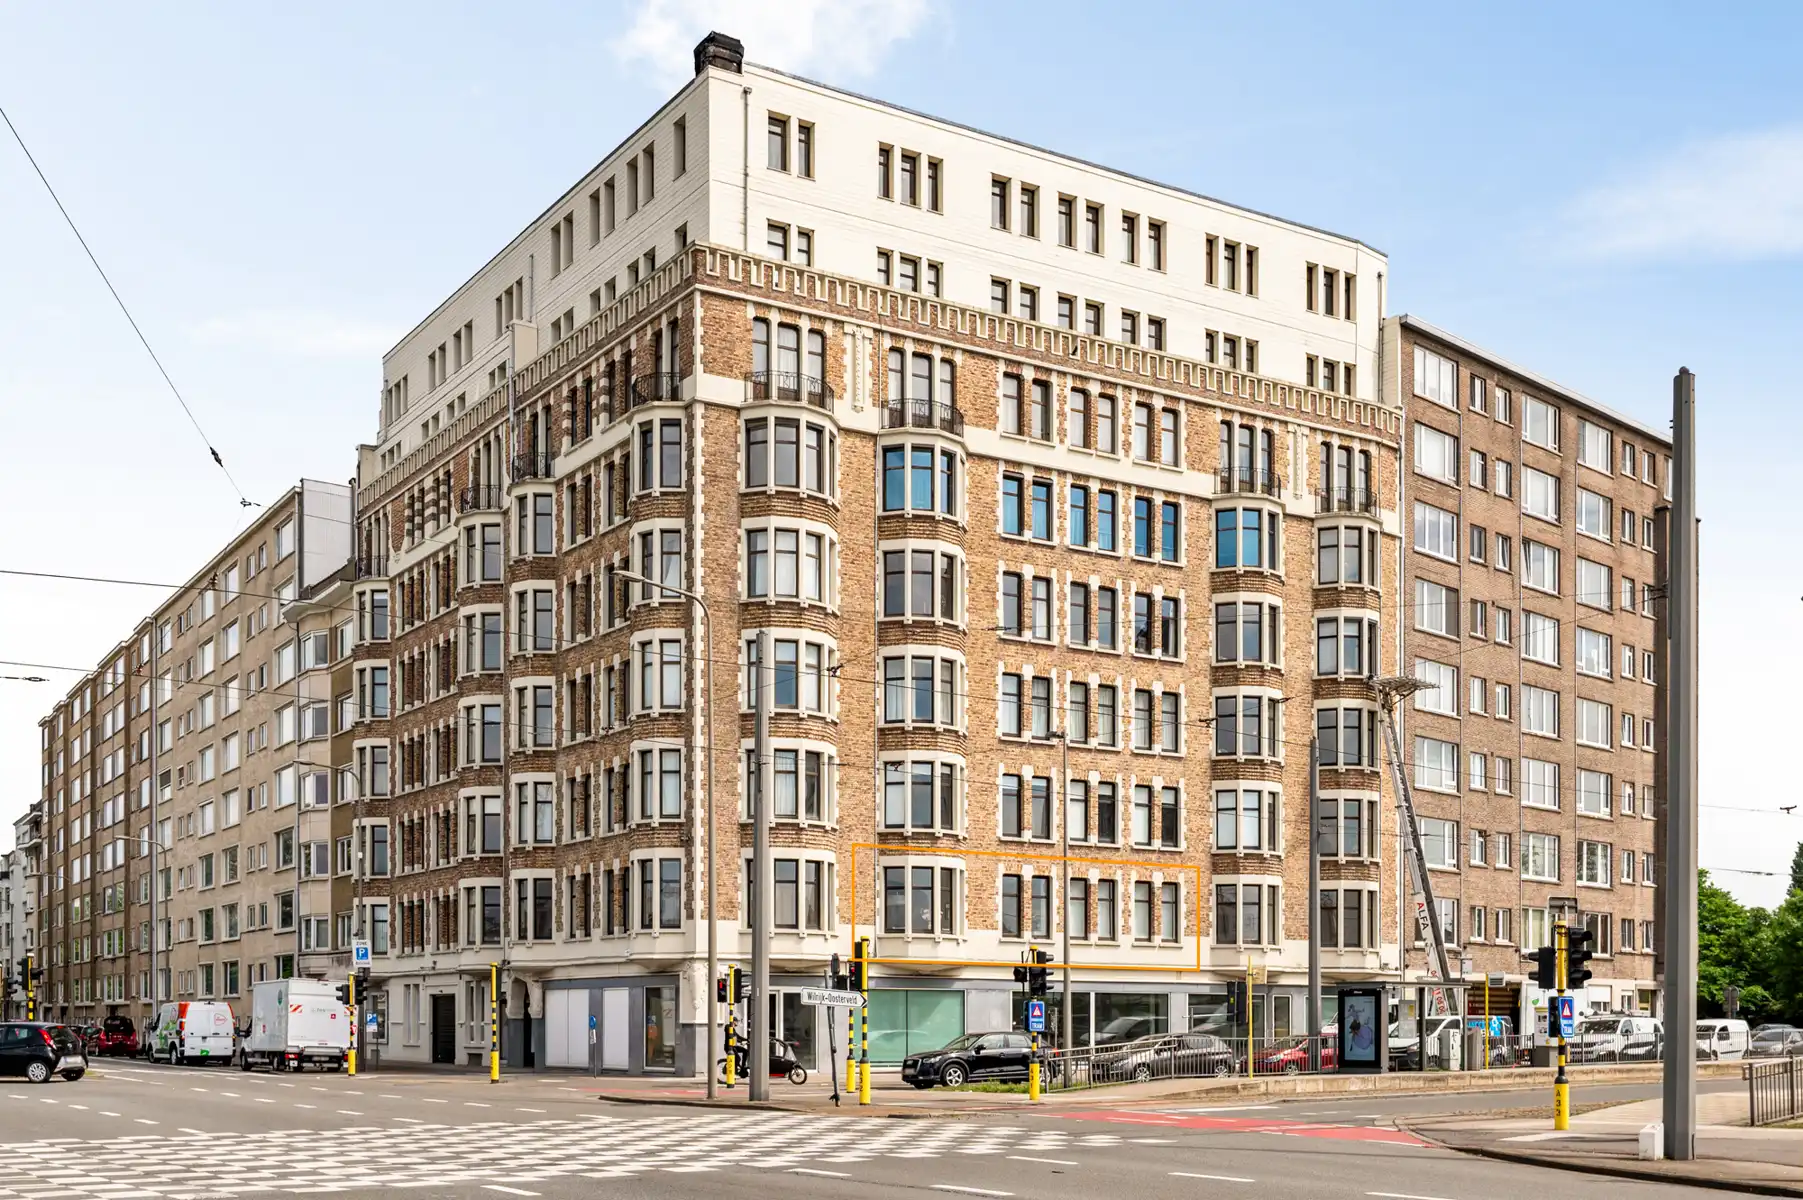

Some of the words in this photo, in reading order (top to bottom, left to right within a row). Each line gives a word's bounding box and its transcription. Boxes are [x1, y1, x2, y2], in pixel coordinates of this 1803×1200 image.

[1417, 902, 1429, 931] ALFA
[358, 948, 365, 957] P
[807, 992, 858, 1004] Wilrijk-Oosterveld
